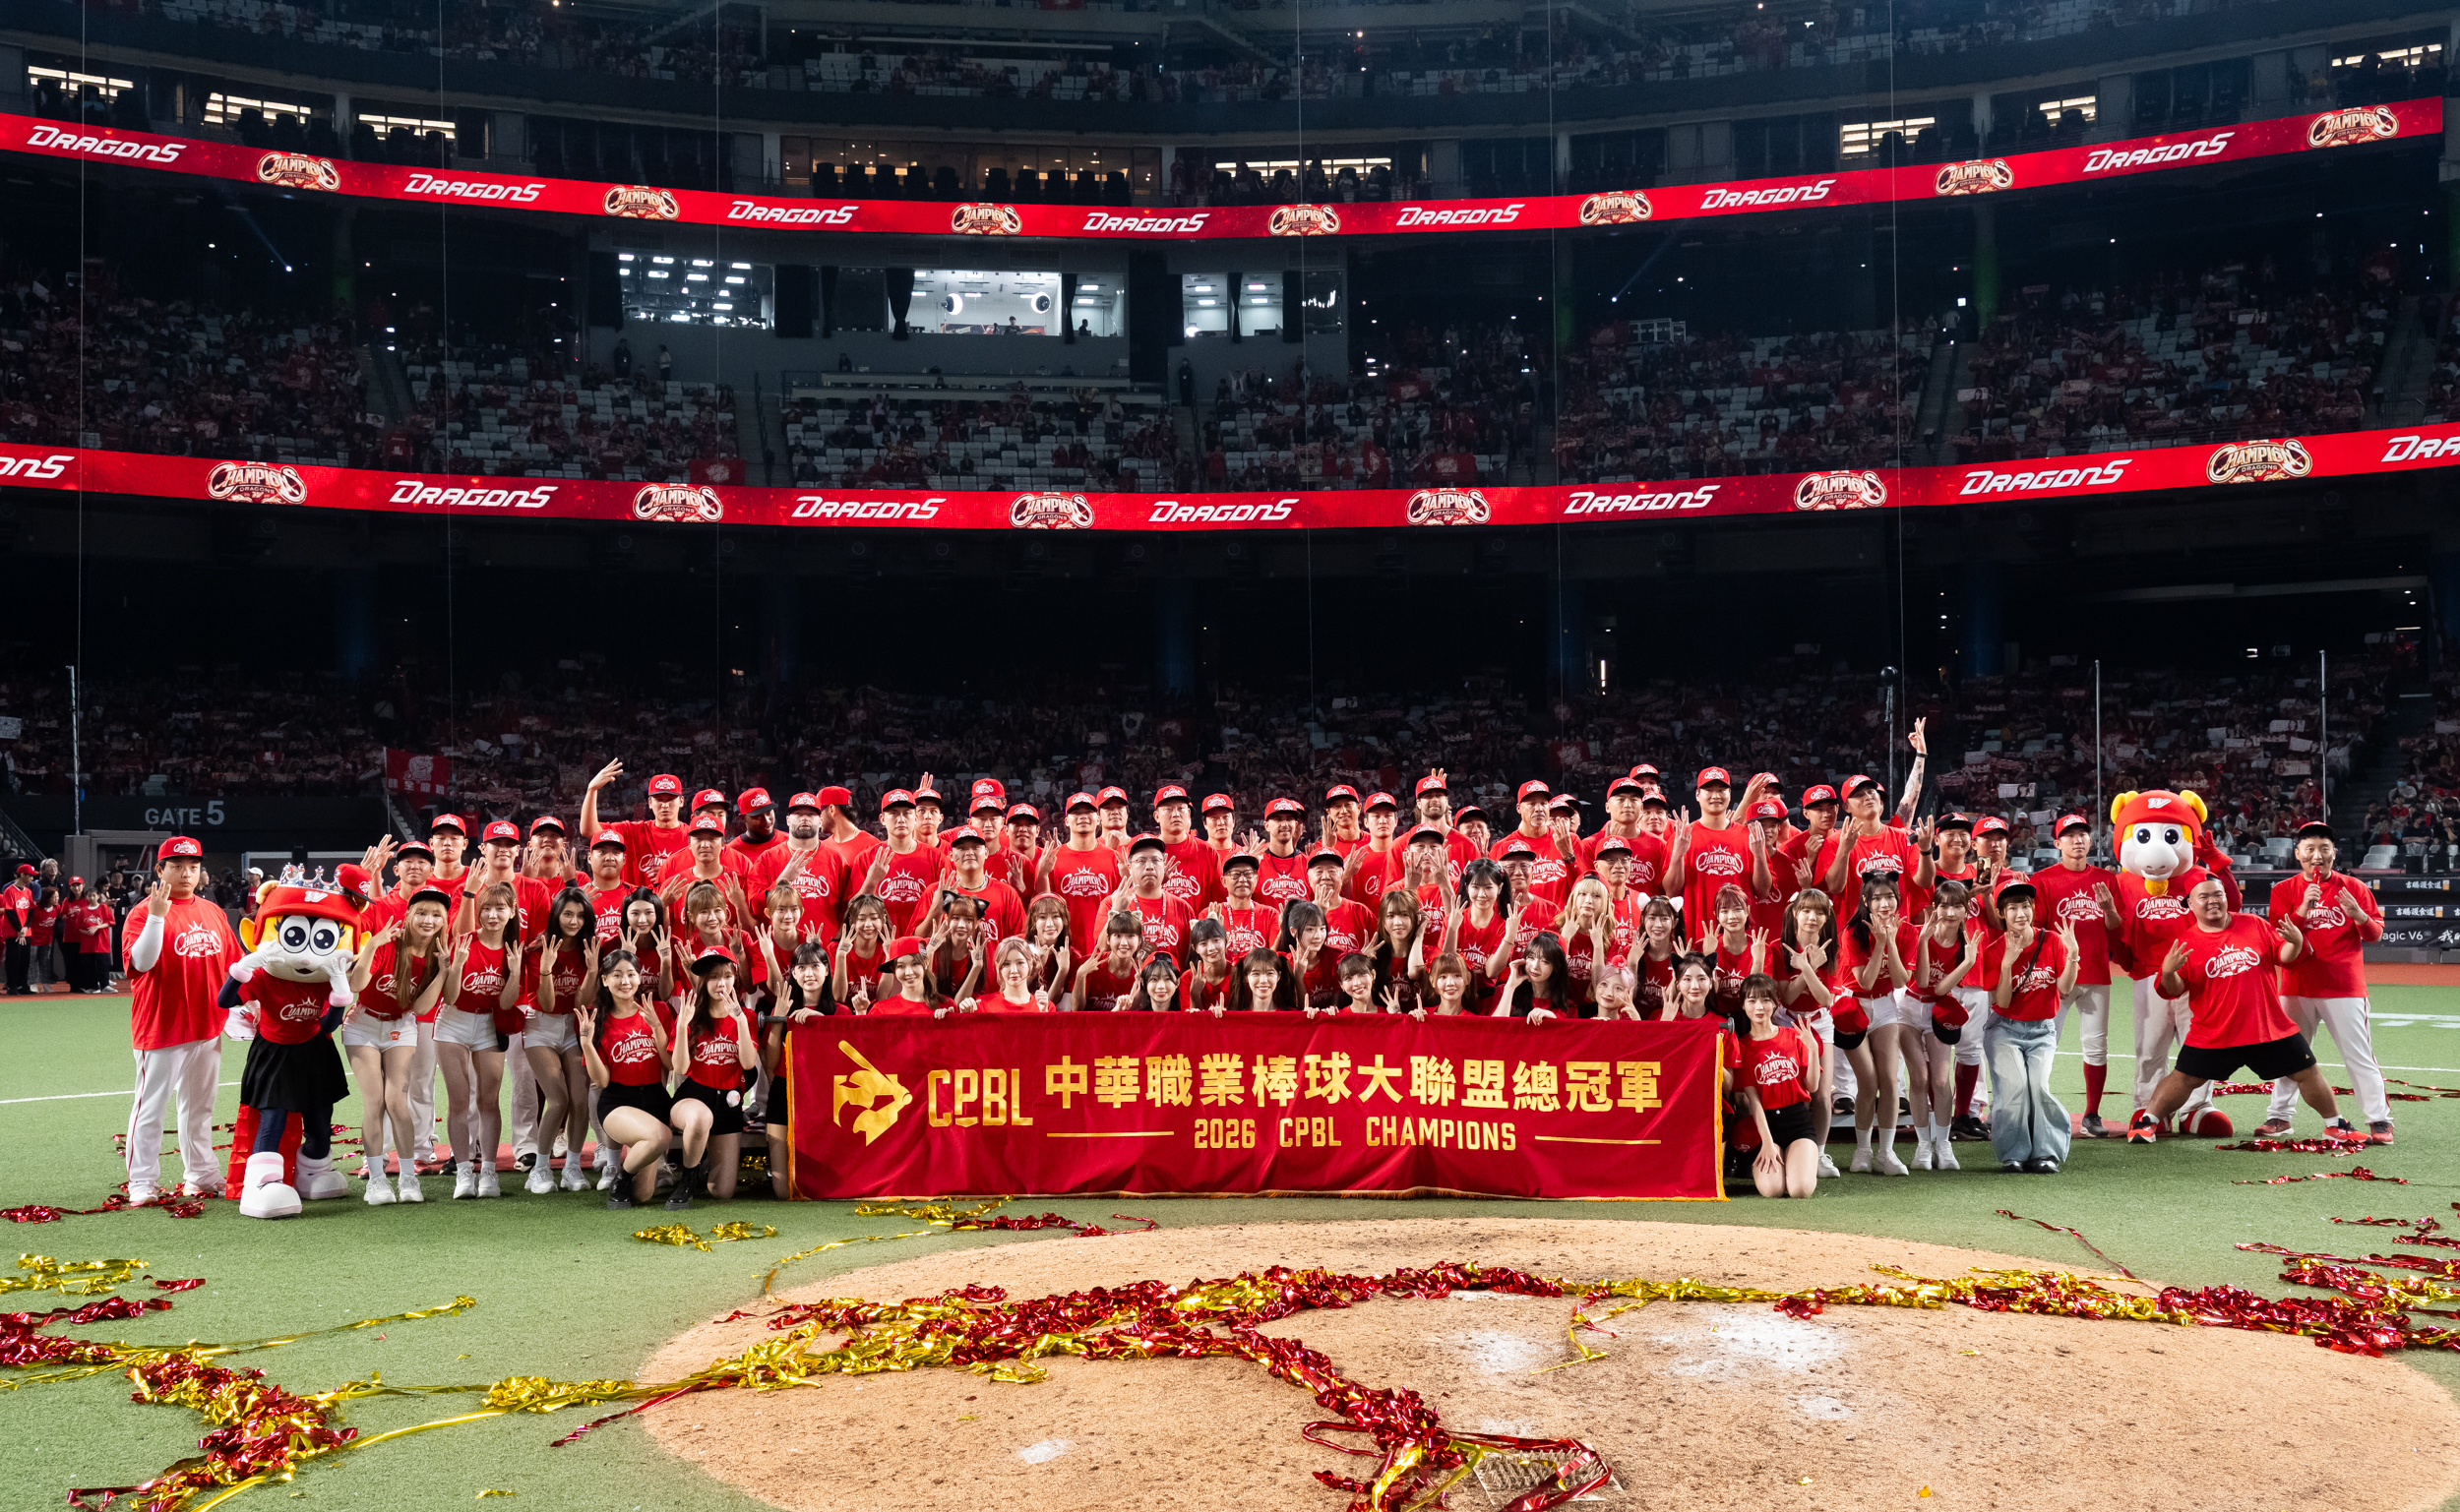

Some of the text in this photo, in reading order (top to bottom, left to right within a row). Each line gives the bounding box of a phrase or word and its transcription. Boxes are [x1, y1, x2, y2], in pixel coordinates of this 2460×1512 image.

[2306, 105, 2399, 148] CHAMPIONS
[27, 125, 187, 163] DRAGONS
[2083, 132, 2236, 172] DRAGONS
[256, 151, 341, 192] CHAMPIONS
[1934, 158, 2014, 196] CHAMPIONS
[403, 173, 546, 203] DRAGONS
[602, 185, 680, 221] CHAMPIONS
[1700, 179, 1836, 210] DRAGONS
[727, 201, 859, 224] DRAGONS
[950, 203, 1022, 234] CHAMPIONS
[1082, 212, 1210, 232] DRAGONS
[1268, 204, 1341, 236] CHAMPIONS
[1396, 204, 1525, 226] DRAGONS
[1578, 191, 1653, 226] CHAMPIONS
[1959, 458, 2133, 495] DRAGONS
[2206, 439, 2312, 483] CHAMPIONS
[206, 460, 308, 506] CHAMPIONS
[389, 480, 559, 509] DRAGONS
[1794, 470, 1887, 511] CHAMPIONS
[633, 483, 723, 522] CHAMPIONS
[791, 496, 947, 519] DRAGONS
[1009, 493, 1095, 528] CHAMPIONS
[1148, 499, 1299, 522] DRAGONS
[1404, 489, 1491, 525] CHAMPIONS
[1564, 485, 1721, 514] DRAGONS
[145, 801, 225, 825] GATE 5
[1696, 852, 1744, 874] CHAMPIONS
[304, 890, 328, 903] W
[1060, 873, 1109, 896] CHAMPIONS
[1261, 878, 1307, 897] CHAMPIONS
[2382, 931, 2406, 942] agic
[2408, 931, 2424, 940] V6
[2205, 947, 2260, 978] CHAMPIONS
[1045, 1052, 1663, 1114] 中華職業棒球大聯盟總冠軍
[1754, 1057, 1799, 1085] CHAMPIONS
[928, 1068, 1033, 1127] CPBL
[1195, 1116, 1516, 1151] 2026 CPBL CHAMPIONS
